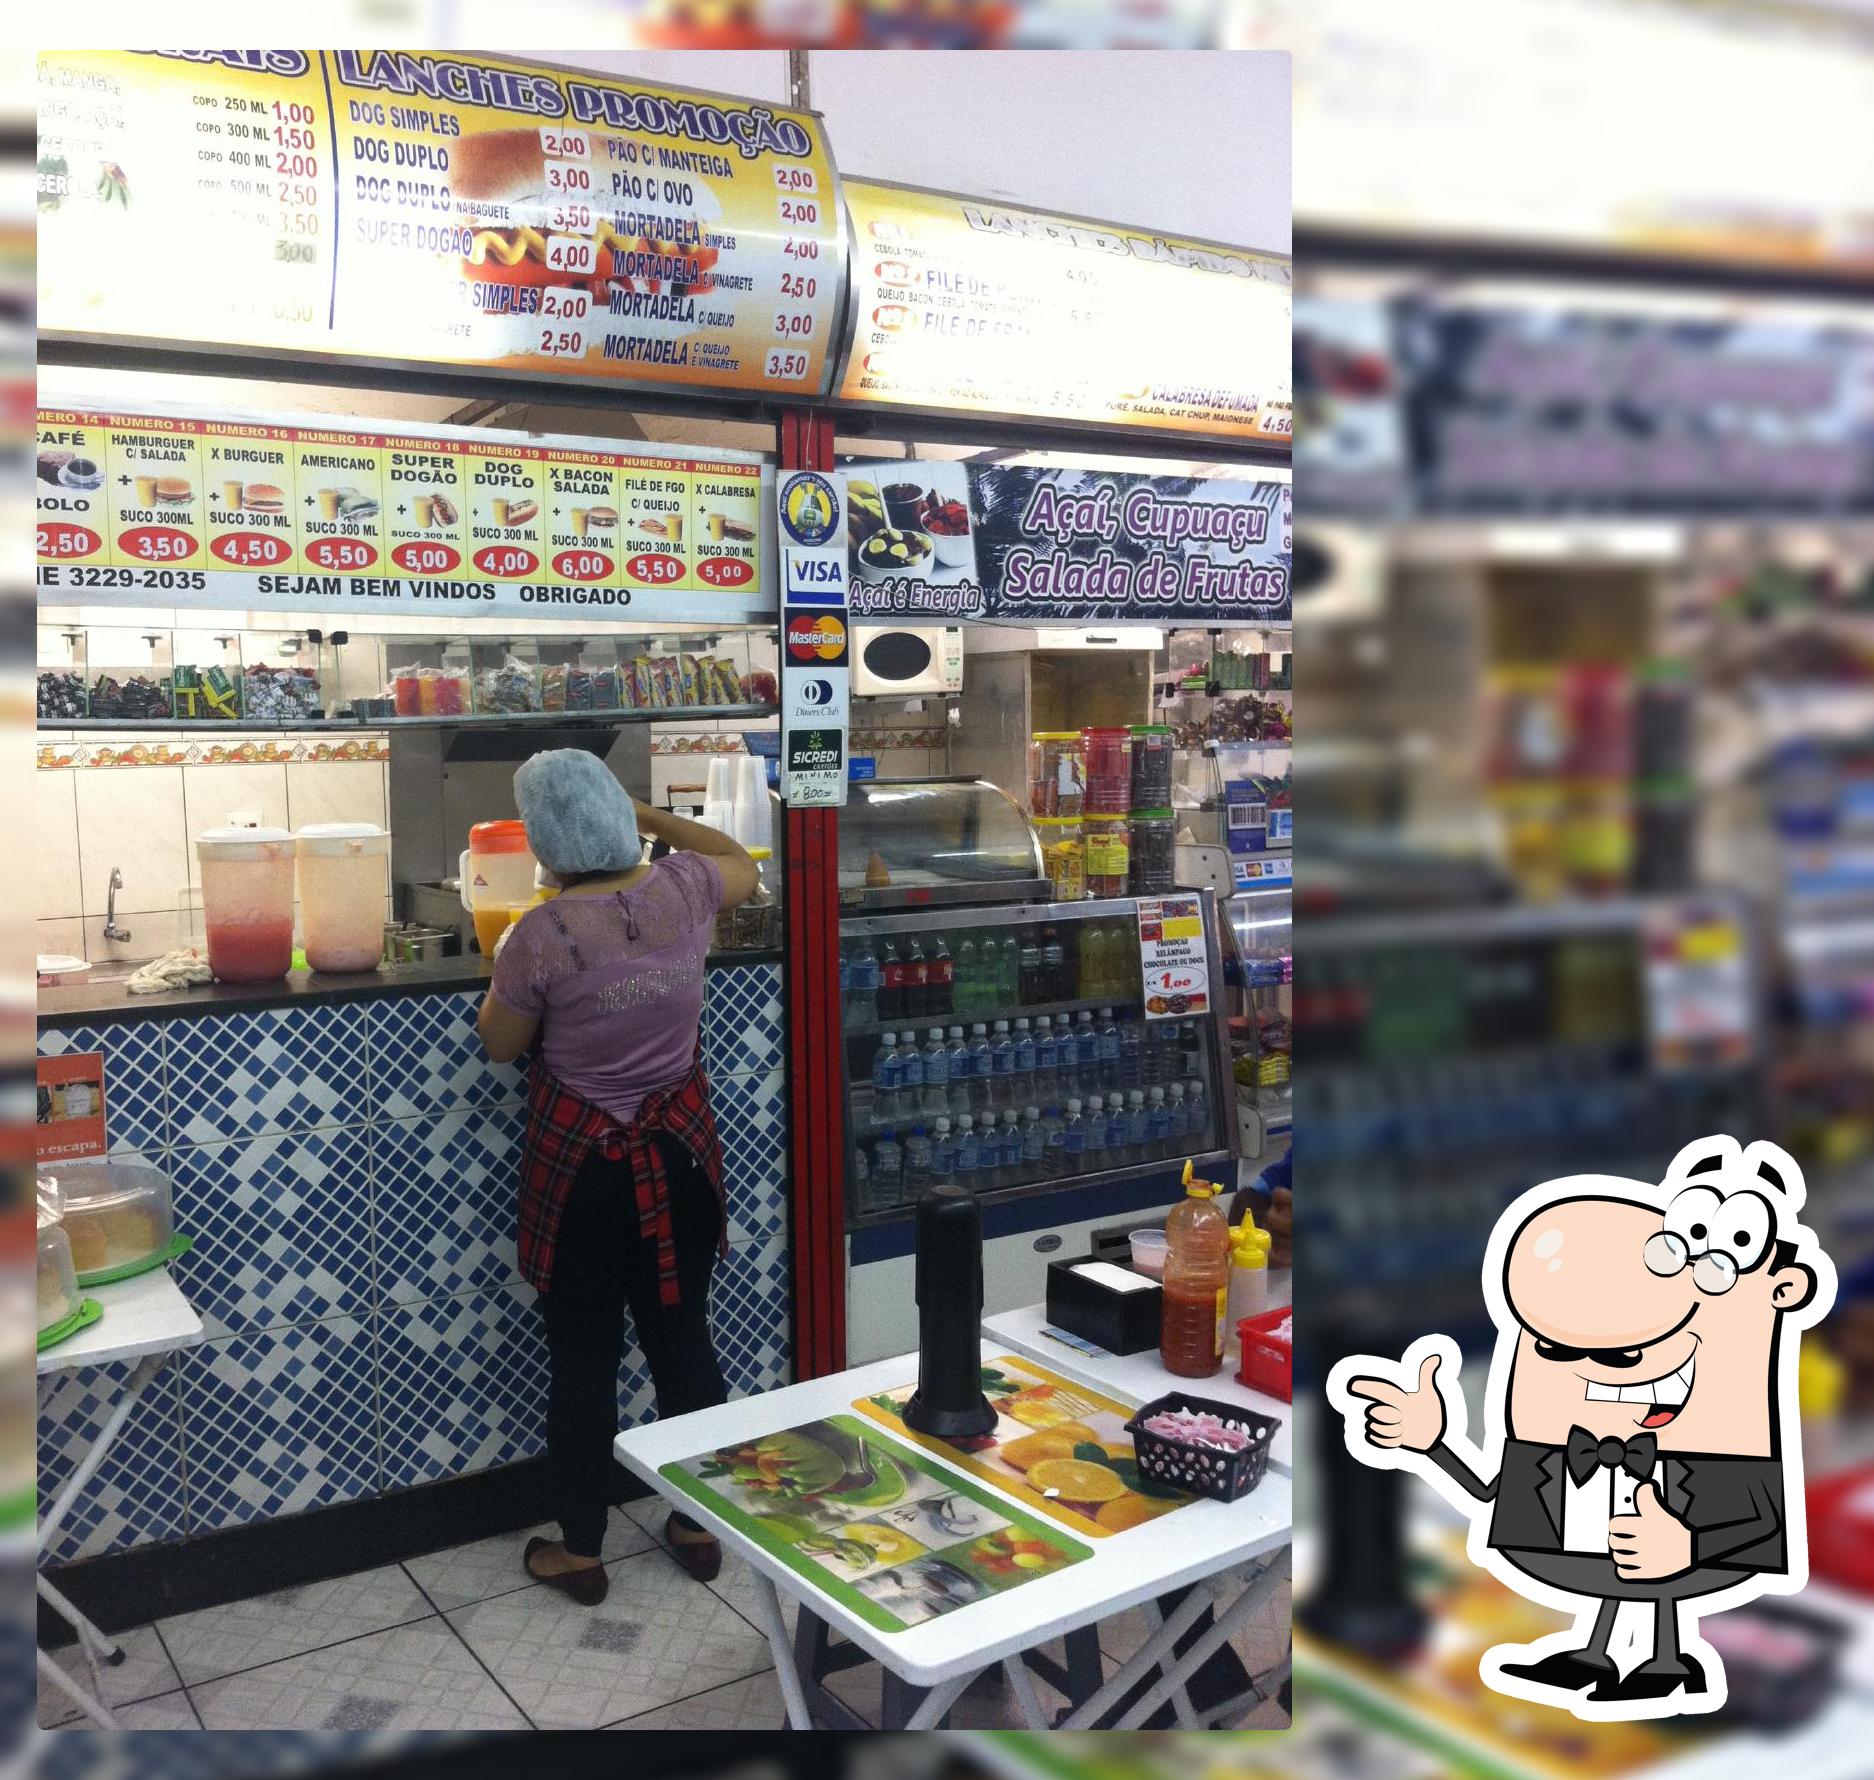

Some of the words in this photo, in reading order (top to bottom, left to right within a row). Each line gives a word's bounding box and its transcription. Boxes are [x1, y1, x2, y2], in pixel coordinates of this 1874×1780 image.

[193, 96, 217, 107] COPO
[225, 97, 247, 111] 250
[251, 101, 268, 114] ML
[272, 100, 315, 125] 1,00
[335, 50, 566, 118] LANCHES
[566, 82, 811, 158] PROMOÇÃO
[349, 100, 385, 126] DOG
[390, 106, 460, 137] SIMPLES
[196, 122, 221, 134] COPO
[227, 123, 249, 138] 300
[253, 127, 270, 141] ML
[273, 125, 315, 150] 1,50
[353, 136, 389, 163] DOG
[394, 142, 449, 171] DUPLO
[545, 135, 585, 157] 2,00
[198, 150, 223, 162] COPO
[229, 151, 250, 166] 400
[255, 154, 271, 168] ML
[276, 152, 318, 178] 2,00
[607, 137, 637, 163] PÃO
[659, 147, 734, 178] MANTEIGA
[230, 180, 251, 194] 500
[256, 183, 271, 197] ML
[549, 168, 590, 193] 3,00
[612, 169, 642, 199] PÃO
[663, 180, 693, 206] OVO
[776, 169, 813, 191] 2,00
[278, 181, 317, 206] 2,50
[356, 175, 390, 204] DOG
[397, 180, 450, 212] DUPLO
[470, 204, 510, 220] BAGUETE
[553, 206, 590, 231] 3,50
[781, 201, 817, 224] 2,00
[357, 218, 410, 248] SUPER
[417, 225, 473, 256] DOGÃO
[614, 210, 700, 246] MORTADELA
[704, 233, 736, 250] SIMPLES
[550, 245, 590, 271] 4,00
[784, 237, 818, 260] 2,00
[613, 250, 699, 285] MORTADELA
[712, 272, 753, 292] VINAGRETE
[780, 273, 816, 299] 2,50
[472, 282, 538, 314] SIMPLES
[544, 296, 587, 320] 2,00
[610, 290, 694, 324] MORTADELA
[707, 311, 735, 328] QUEIJO
[775, 314, 813, 339] 3,00
[541, 330, 581, 356] 2,50
[603, 334, 688, 366] MORTADELA
[702, 343, 730, 356] QUEIJO
[698, 358, 739, 371] VINAGRETE
[768, 355, 806, 379] 3,50
[82, 414, 99, 425] 14
[1170, 408, 1185, 417] CAT
[110, 416, 173, 431] NUMERO
[178, 421, 196, 432] 15
[207, 423, 268, 438] NUMERO
[271, 429, 288, 440] 16
[111, 434, 195, 451] HAMBURGUER
[298, 431, 356, 445] NUMERO
[360, 436, 376, 446] 17
[385, 437, 442, 451] NUMERO
[444, 442, 460, 452] 18
[126, 448, 137, 460] C/
[140, 449, 186, 462] SALADA
[211, 447, 220, 460] X
[223, 448, 284, 465] BURGUER
[391, 454, 455, 470] SUPER
[469, 445, 521, 457] NUMERO
[525, 448, 540, 459] 19
[548, 451, 598, 463] NUMERO
[600, 454, 616, 465] 20
[301, 454, 375, 471] AMERICANO
[484, 461, 523, 475] DOG
[623, 457, 671, 469] NUMERO
[674, 461, 688, 470] 21
[695, 463, 742, 474] NUMERO
[744, 466, 757, 475] 22
[390, 466, 458, 485] DOGÃO
[474, 472, 535, 489] DUPLO
[549, 467, 560, 479] X
[563, 468, 613, 483] BACON
[553, 480, 610, 496] SALADA
[625, 477, 647, 492] FILÉ
[648, 479, 660, 492] DE
[662, 481, 685, 494] FGO
[696, 483, 703, 495] X
[704, 484, 756, 499] CALABRESA
[631, 498, 641, 511] C/
[644, 499, 680, 513] QUEIJO
[120, 509, 153, 523] SUCO
[156, 511, 194, 525] 300ML
[209, 511, 244, 525] SUCO
[248, 513, 270, 527] 300
[274, 514, 291, 528] ML
[1023, 483, 1116, 541] Açaí,
[1124, 486, 1268, 552] Cupuaçu
[305, 521, 338, 535] SUCO
[341, 523, 360, 536] 300
[364, 524, 379, 537] ML
[391, 530, 421, 539] SUCO
[423, 532, 443, 540] 300
[445, 533, 460, 541] ML
[472, 527, 501, 539] SUCO
[503, 528, 522, 541] 300
[524, 529, 539, 542] ML
[138, 536, 188, 561] 3,50
[551, 534, 578, 547] SUCO
[580, 536, 598, 548] 300
[600, 537, 614, 549] ML
[626, 540, 652, 552] SUCO
[654, 542, 670, 553] 300
[672, 543, 686, 554] ML
[697, 545, 721, 556] SUCO
[723, 546, 738, 557] 300
[740, 547, 754, 558] ML
[223, 540, 278, 564] 4,50
[319, 545, 368, 569] 5,50
[405, 549, 448, 573] 5,00
[483, 551, 529, 576] 4,00
[562, 555, 604, 580] 6,00
[636, 559, 678, 583] 5,50
[794, 560, 842, 582] VISA
[70, 568, 206, 589] 3229-2035
[705, 564, 742, 584] 5,00
[1003, 550, 1134, 604] Salada
[1137, 553, 1178, 603] de
[1184, 557, 1288, 604] Frutas
[258, 575, 341, 596] SEJAM
[351, 578, 401, 597] BEM
[409, 581, 496, 601] VINDOS
[519, 585, 631, 607] OBRIGADO
[849, 578, 893, 615] Açaí
[895, 580, 909, 610] é
[910, 580, 981, 614] Energia
[789, 632, 845, 646] MasterCard
[795, 707, 820, 717] Diners
[821, 706, 839, 716] Club
[793, 751, 838, 763] SICREDI
[1160, 972, 1191, 990] 1,00
